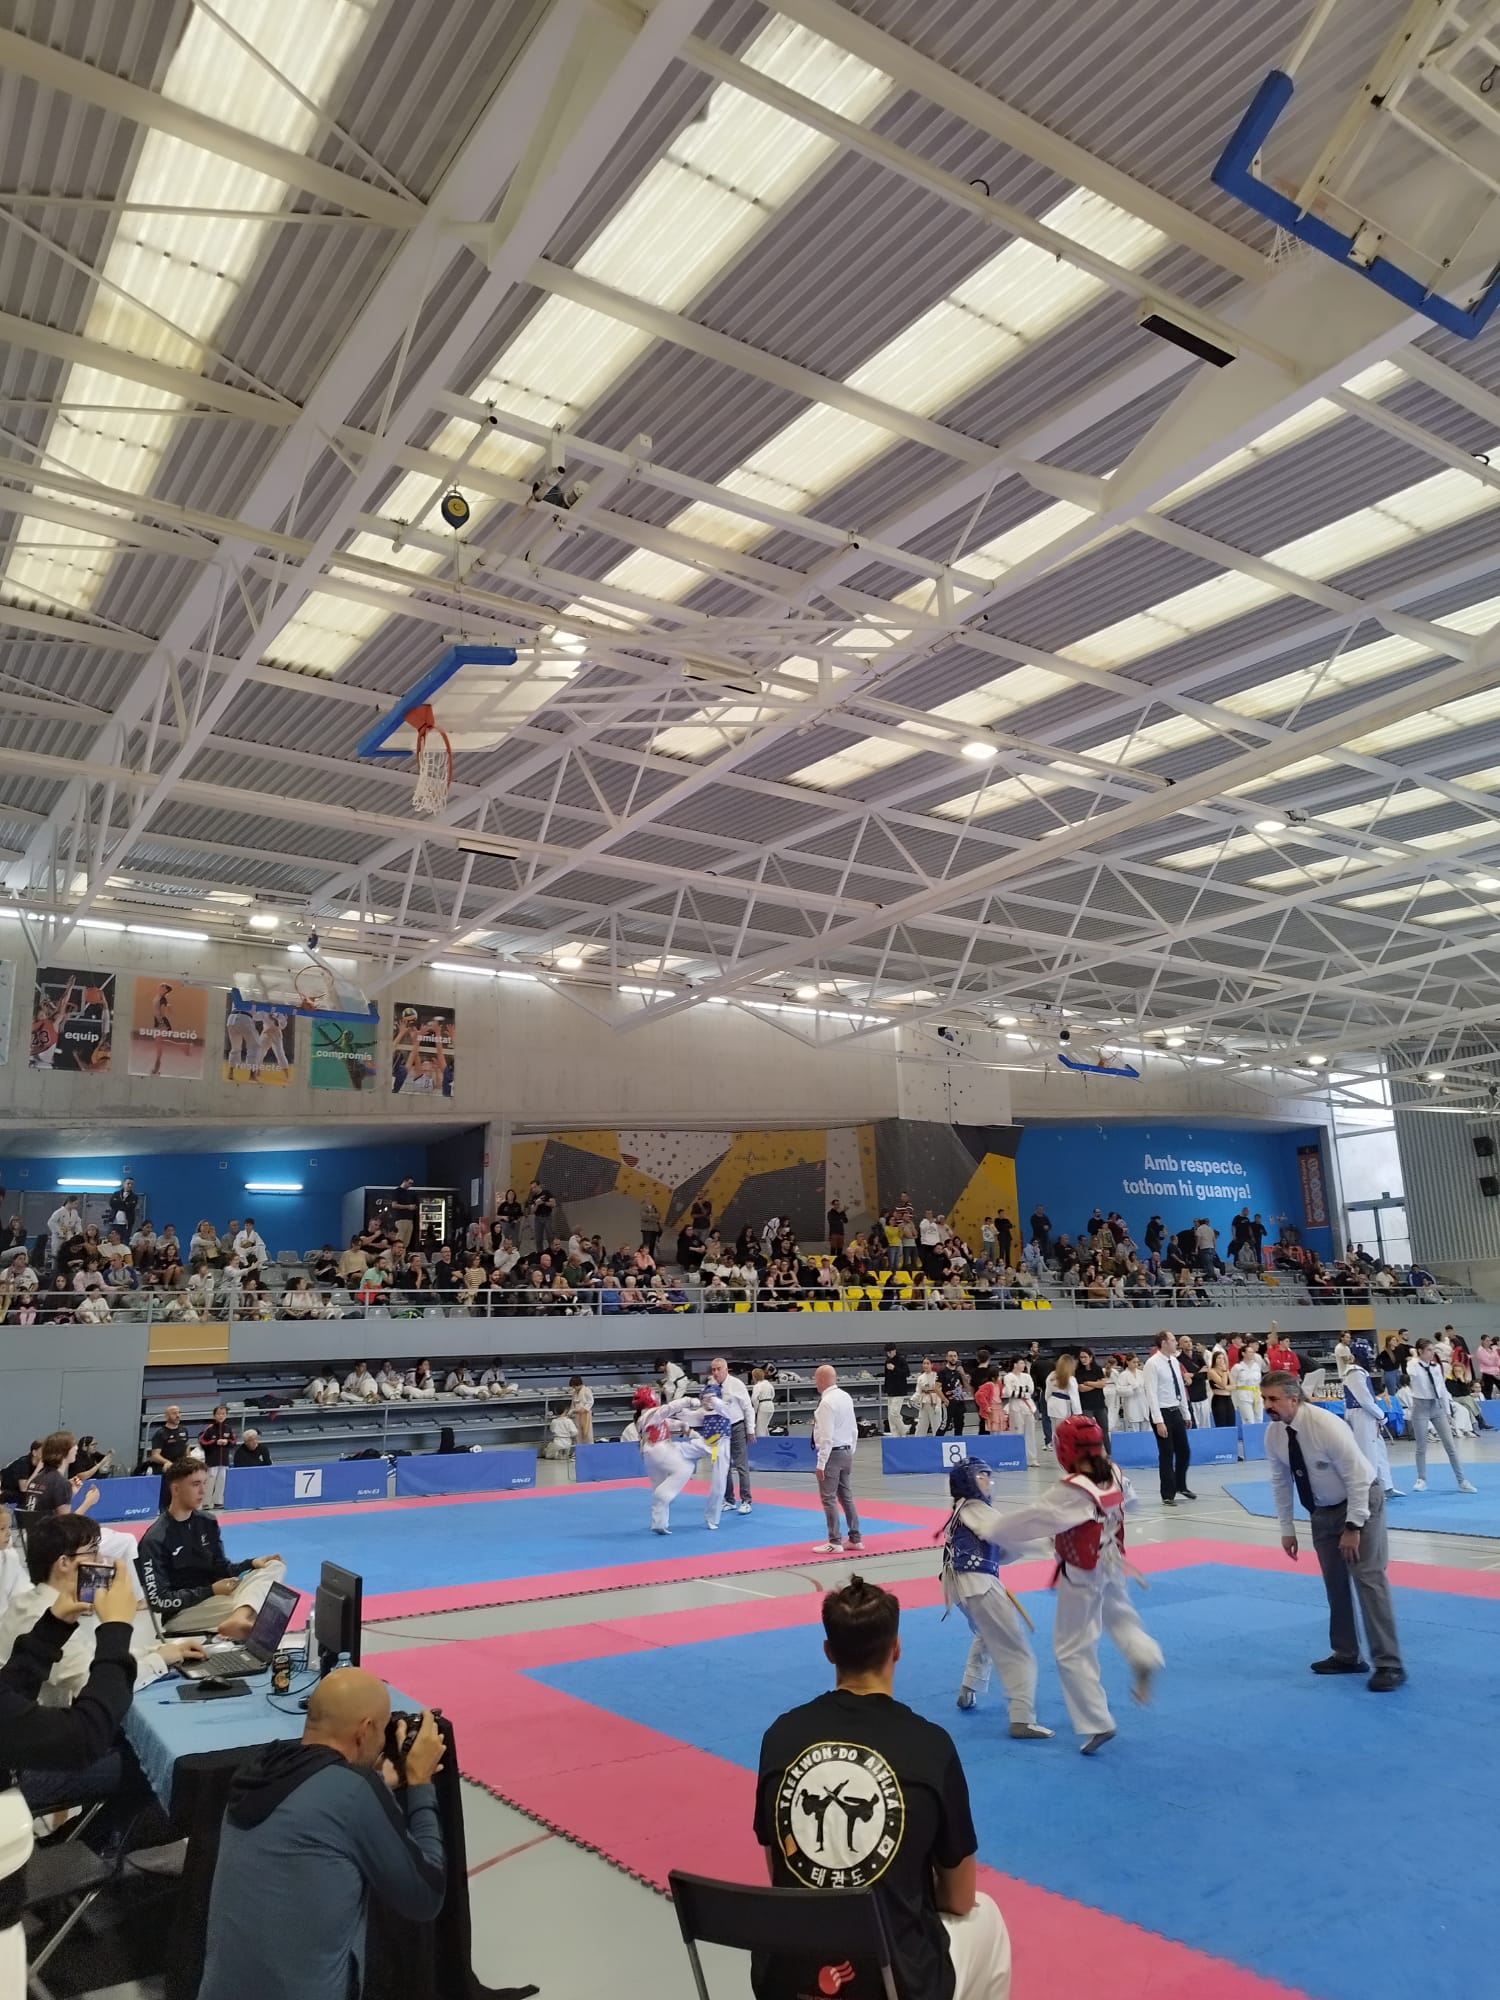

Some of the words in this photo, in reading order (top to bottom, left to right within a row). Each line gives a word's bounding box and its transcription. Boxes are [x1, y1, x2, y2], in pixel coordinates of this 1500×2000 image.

[64, 1031, 99, 1043] equip
[139, 1027, 198, 1040] superació
[417, 1034, 452, 1044] amistat
[316, 1048, 372, 1061] compromís
[235, 1062, 282, 1073] respecte
[1144, 1154, 1178, 1172] Amb
[1180, 1159, 1247, 1177] respecte,
[1122, 1178, 1177, 1195] tothom
[1178, 1179, 1194, 1196] hi
[1195, 1183, 1252, 1202] guanya!
[949, 1444, 962, 1464] 8
[302, 1472, 316, 1494] 7
[779, 1747, 858, 1809] TAEKWON-DO
[863, 1756, 900, 1810] ALELLA
[810, 1866, 866, 1888] 태권도
